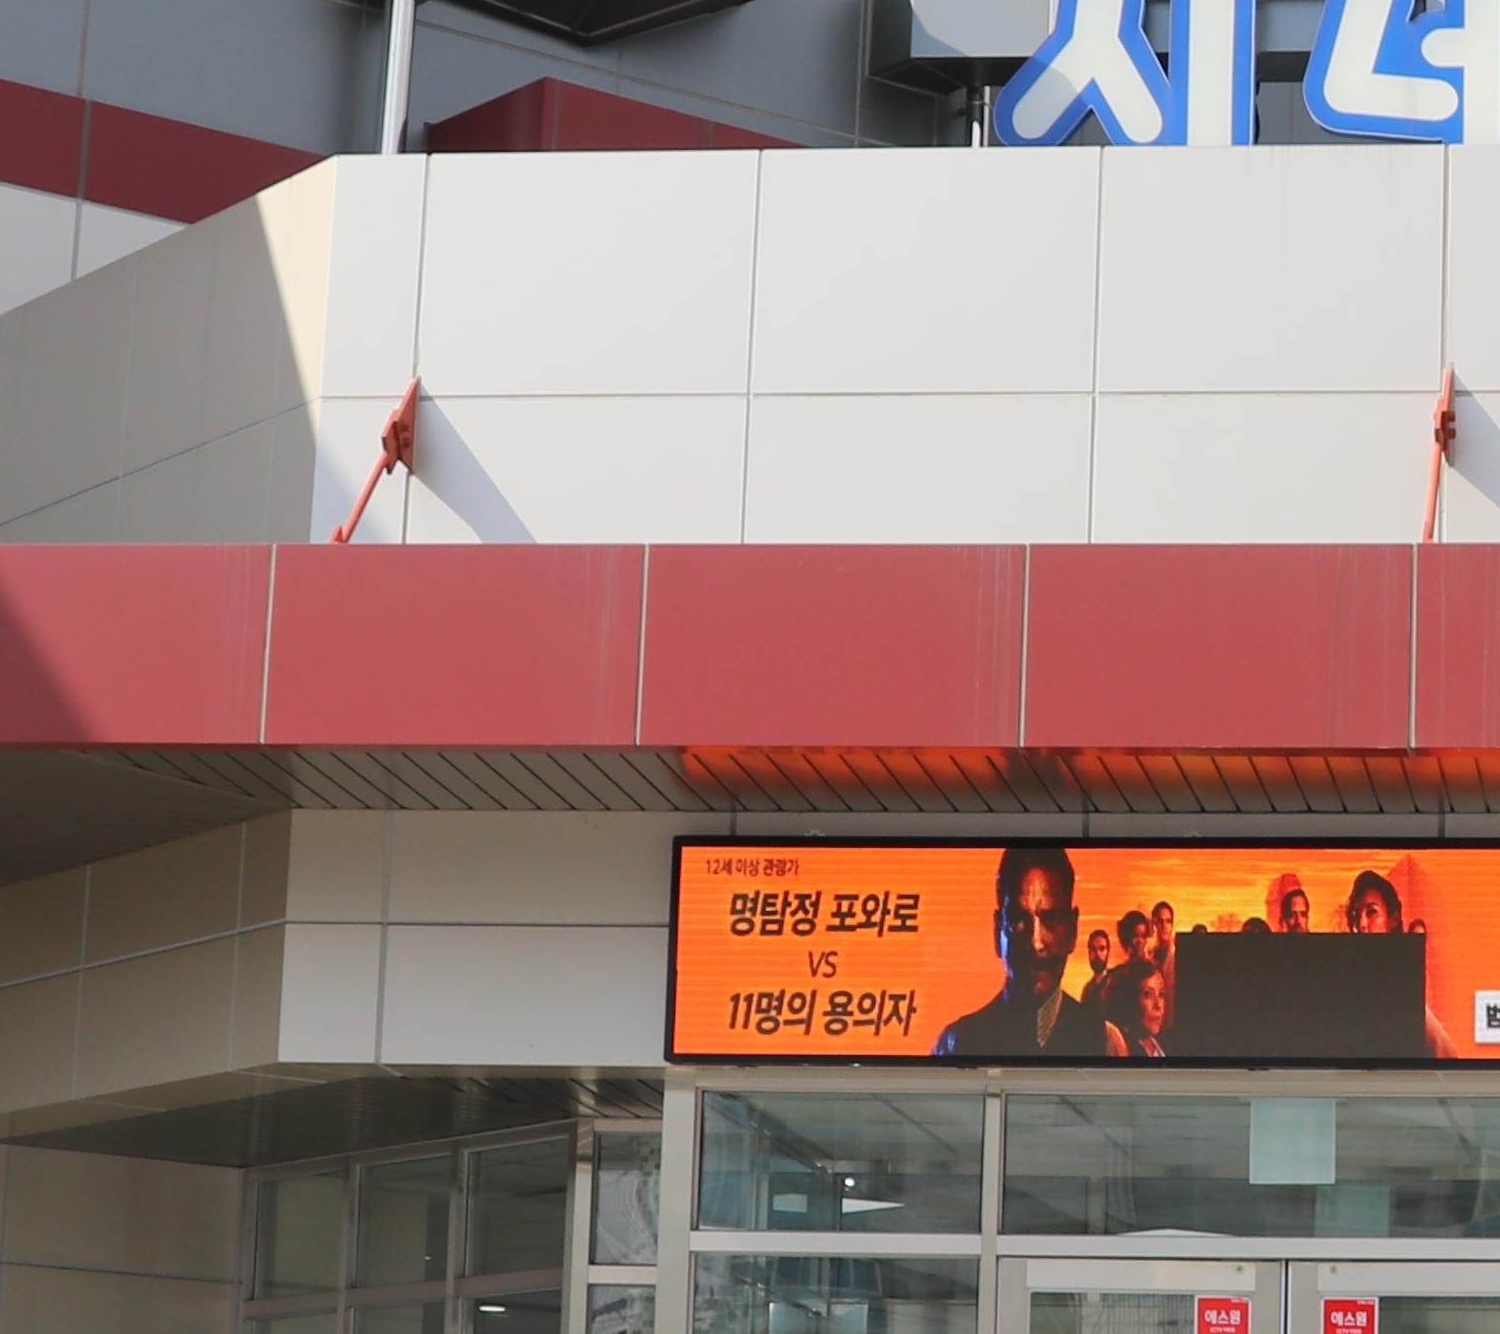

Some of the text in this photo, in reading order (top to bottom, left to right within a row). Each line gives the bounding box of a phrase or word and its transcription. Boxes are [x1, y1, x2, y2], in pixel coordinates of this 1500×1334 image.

[706, 858, 799, 877] 12세 이상 관람가
[730, 890, 920, 937] 명탐정 포와로
[808, 950, 838, 978] VS
[729, 989, 917, 1036] 11명의 용의자
[1204, 1309, 1241, 1325] 에스원
[1331, 1311, 1368, 1327] 에스원
